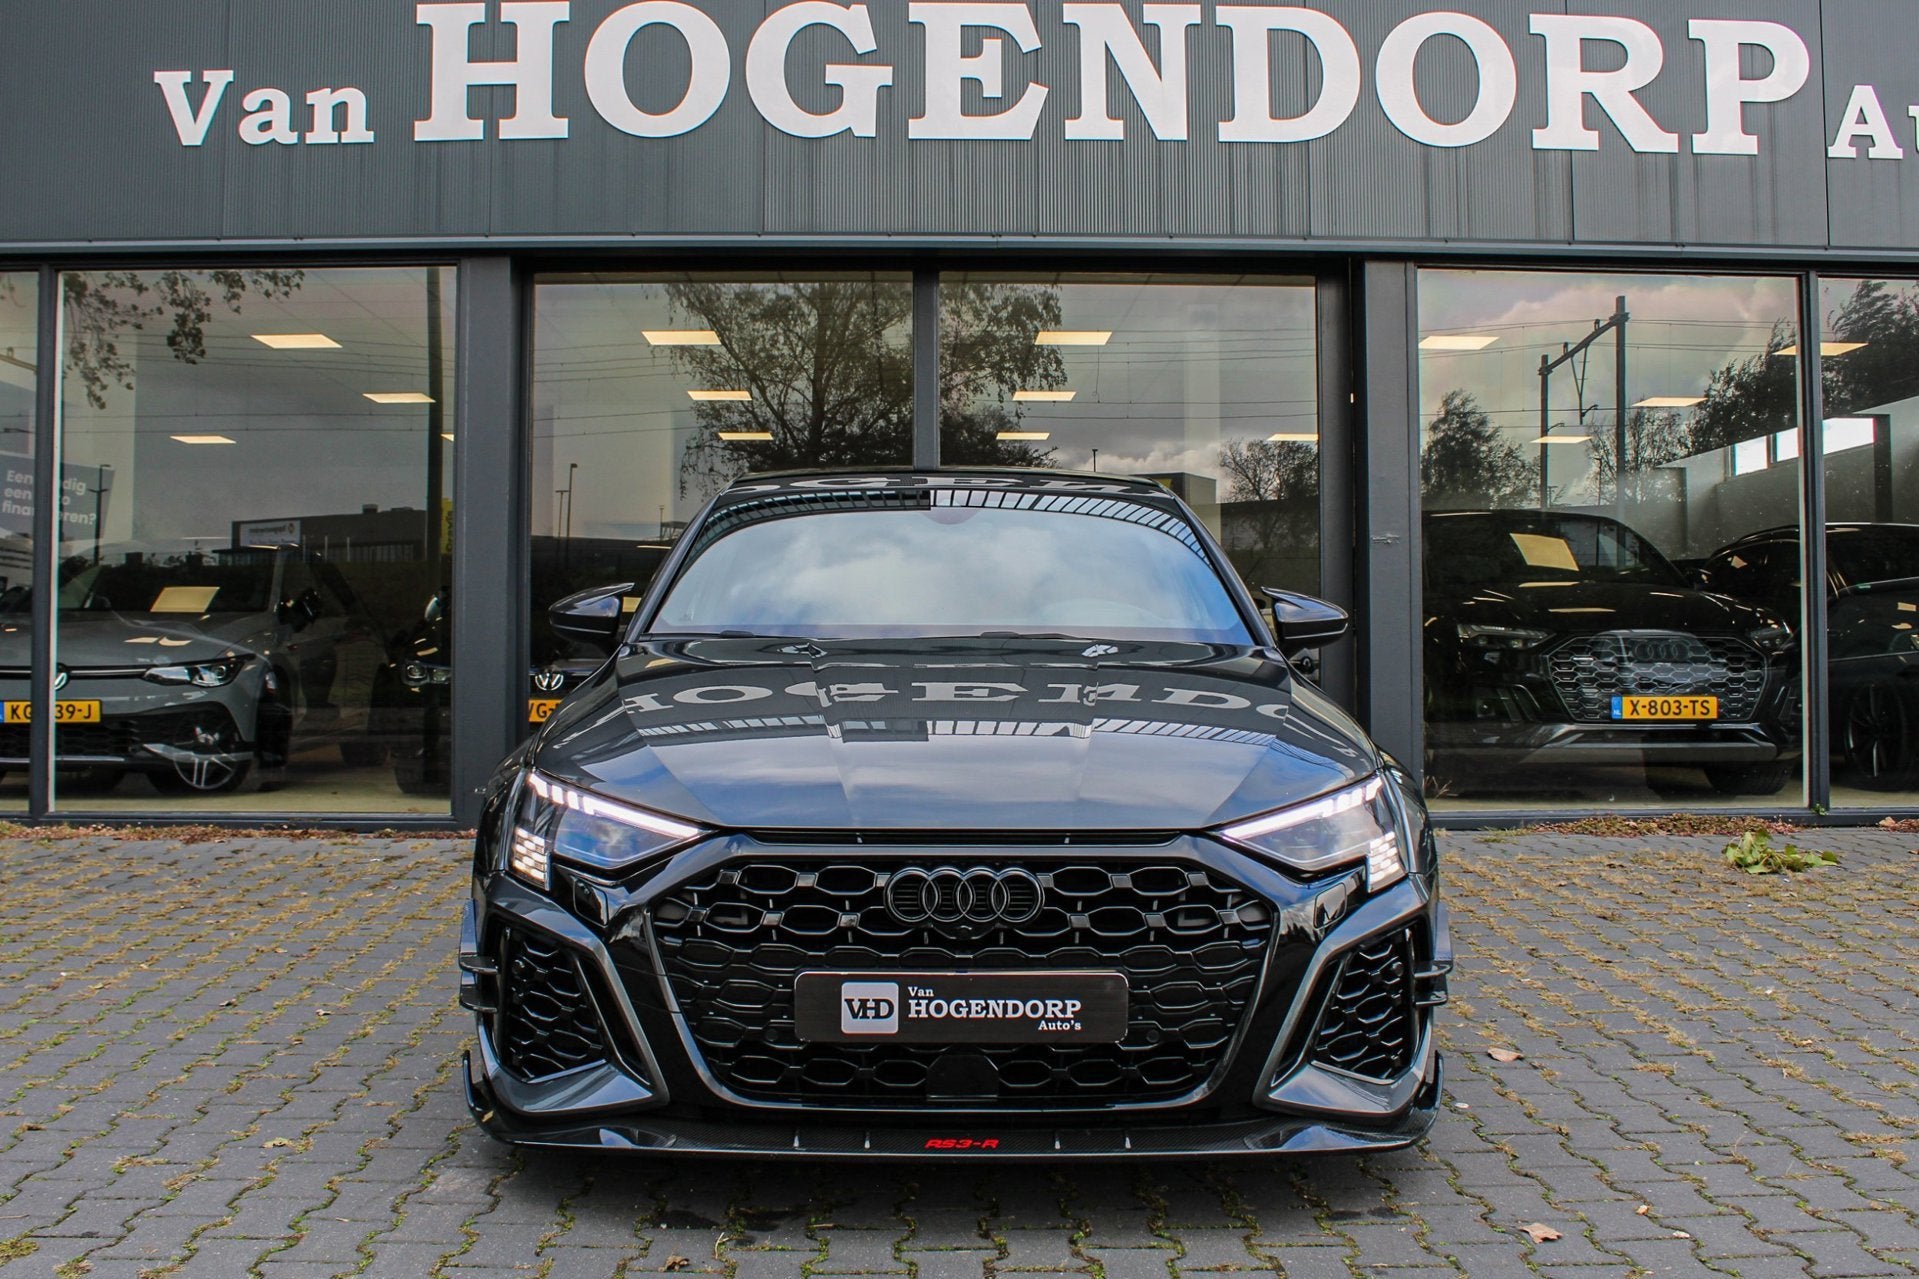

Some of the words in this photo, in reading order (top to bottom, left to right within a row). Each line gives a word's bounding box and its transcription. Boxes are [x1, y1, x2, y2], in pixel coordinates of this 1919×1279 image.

[153, 69, 375, 147] Van
[413, 0, 1811, 156] HOGENDORP
[1826, 84, 1919, 161] A
[1629, 699, 1711, 716] X-803-TS
[907, 986, 935, 997] Van
[843, 997, 896, 1020] VHD
[908, 999, 1082, 1019] HOGENDORP
[1037, 1019, 1082, 1031] Auto's
[924, 1138, 1000, 1150] RS3-R
